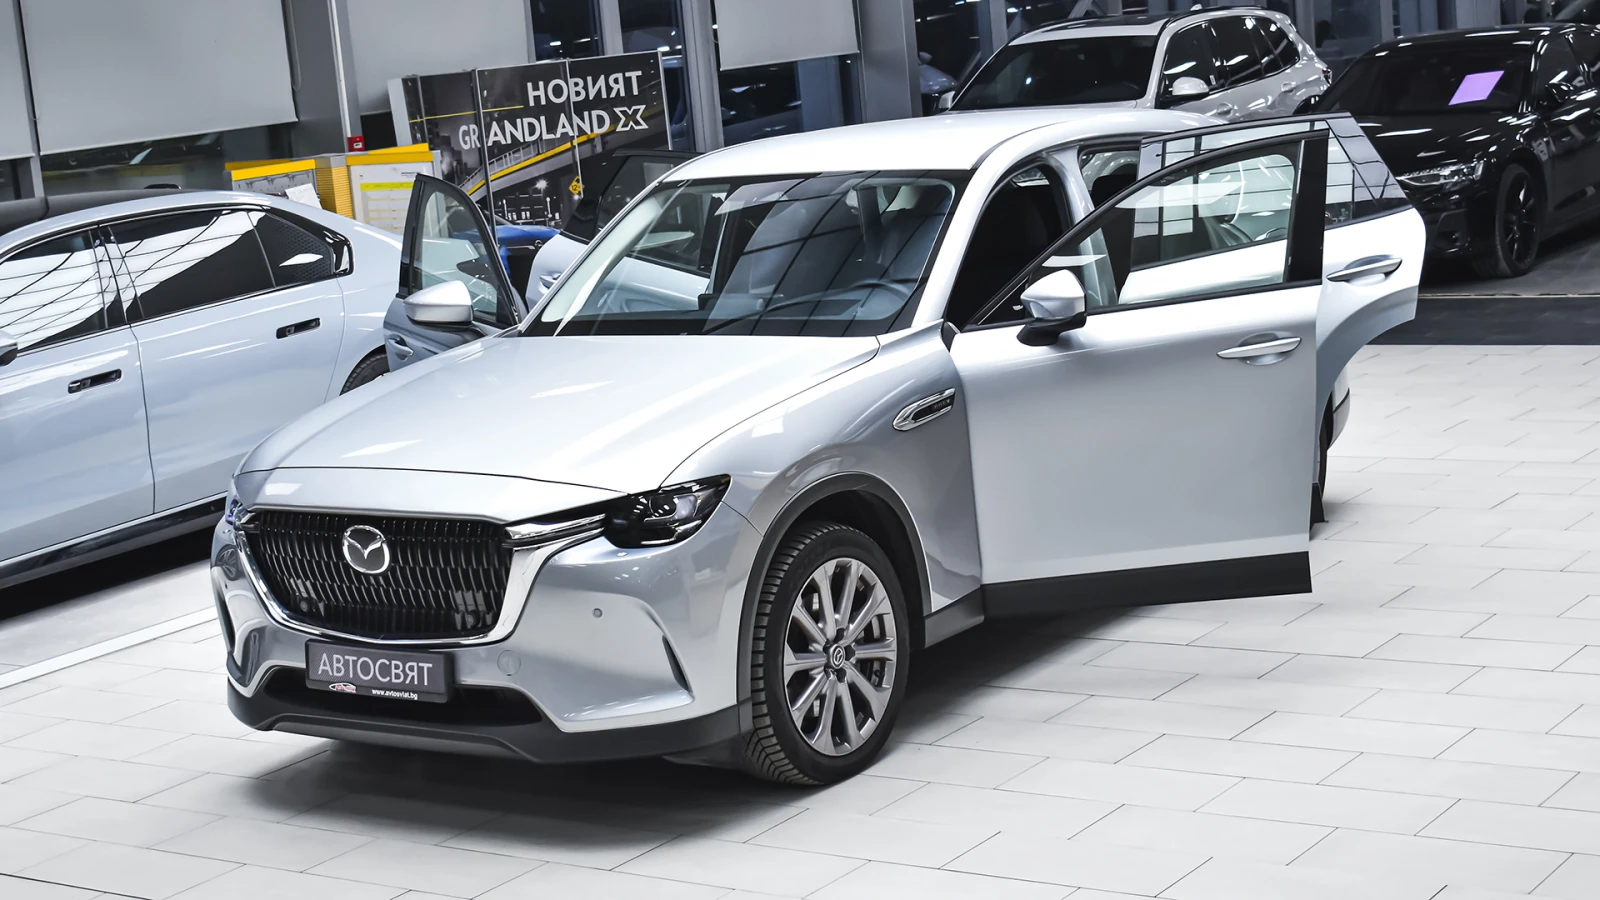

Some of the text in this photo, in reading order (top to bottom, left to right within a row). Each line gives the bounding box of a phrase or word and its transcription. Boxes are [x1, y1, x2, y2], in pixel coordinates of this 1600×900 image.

[526, 70, 643, 107] НОВИЯТ
[458, 105, 649, 150] GRANDLAND X
[318, 653, 433, 686] АВТОСВЯТ
